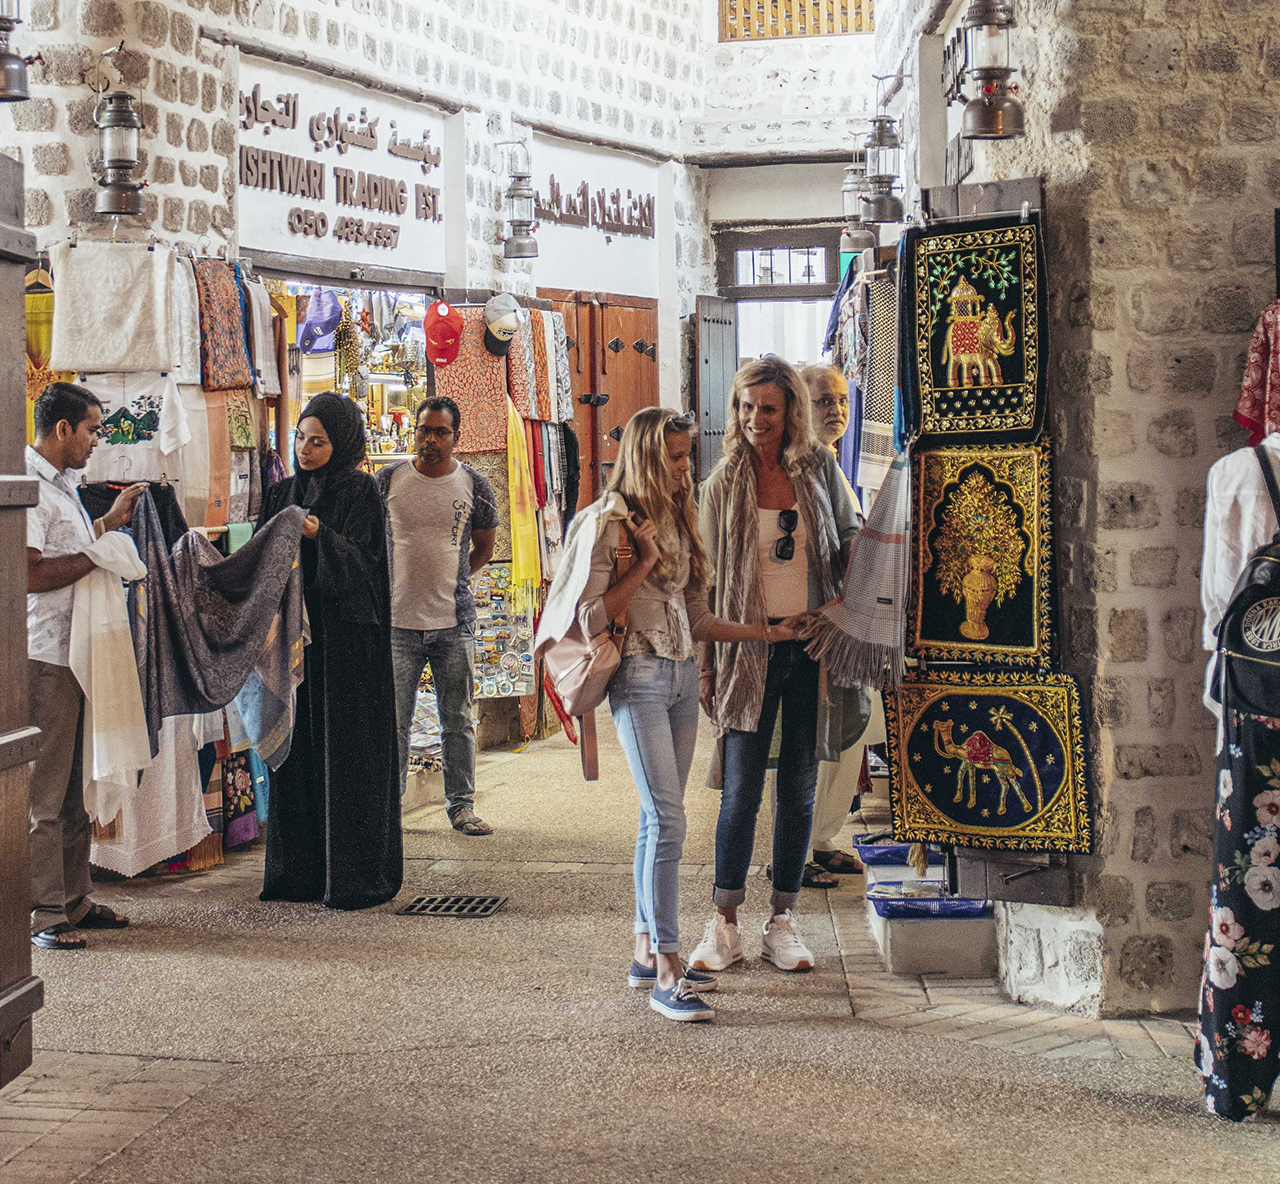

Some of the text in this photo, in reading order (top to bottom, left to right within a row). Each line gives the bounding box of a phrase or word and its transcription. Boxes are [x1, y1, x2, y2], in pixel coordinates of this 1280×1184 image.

[239, 83, 299, 137] التجار
[388, 120, 441, 174] مؤسسة
[239, 144, 443, 222] ISHTWARI TRADING EST.
[288, 207, 400, 249] 050 4834357
[1245, 605, 1262, 627] DONNA
